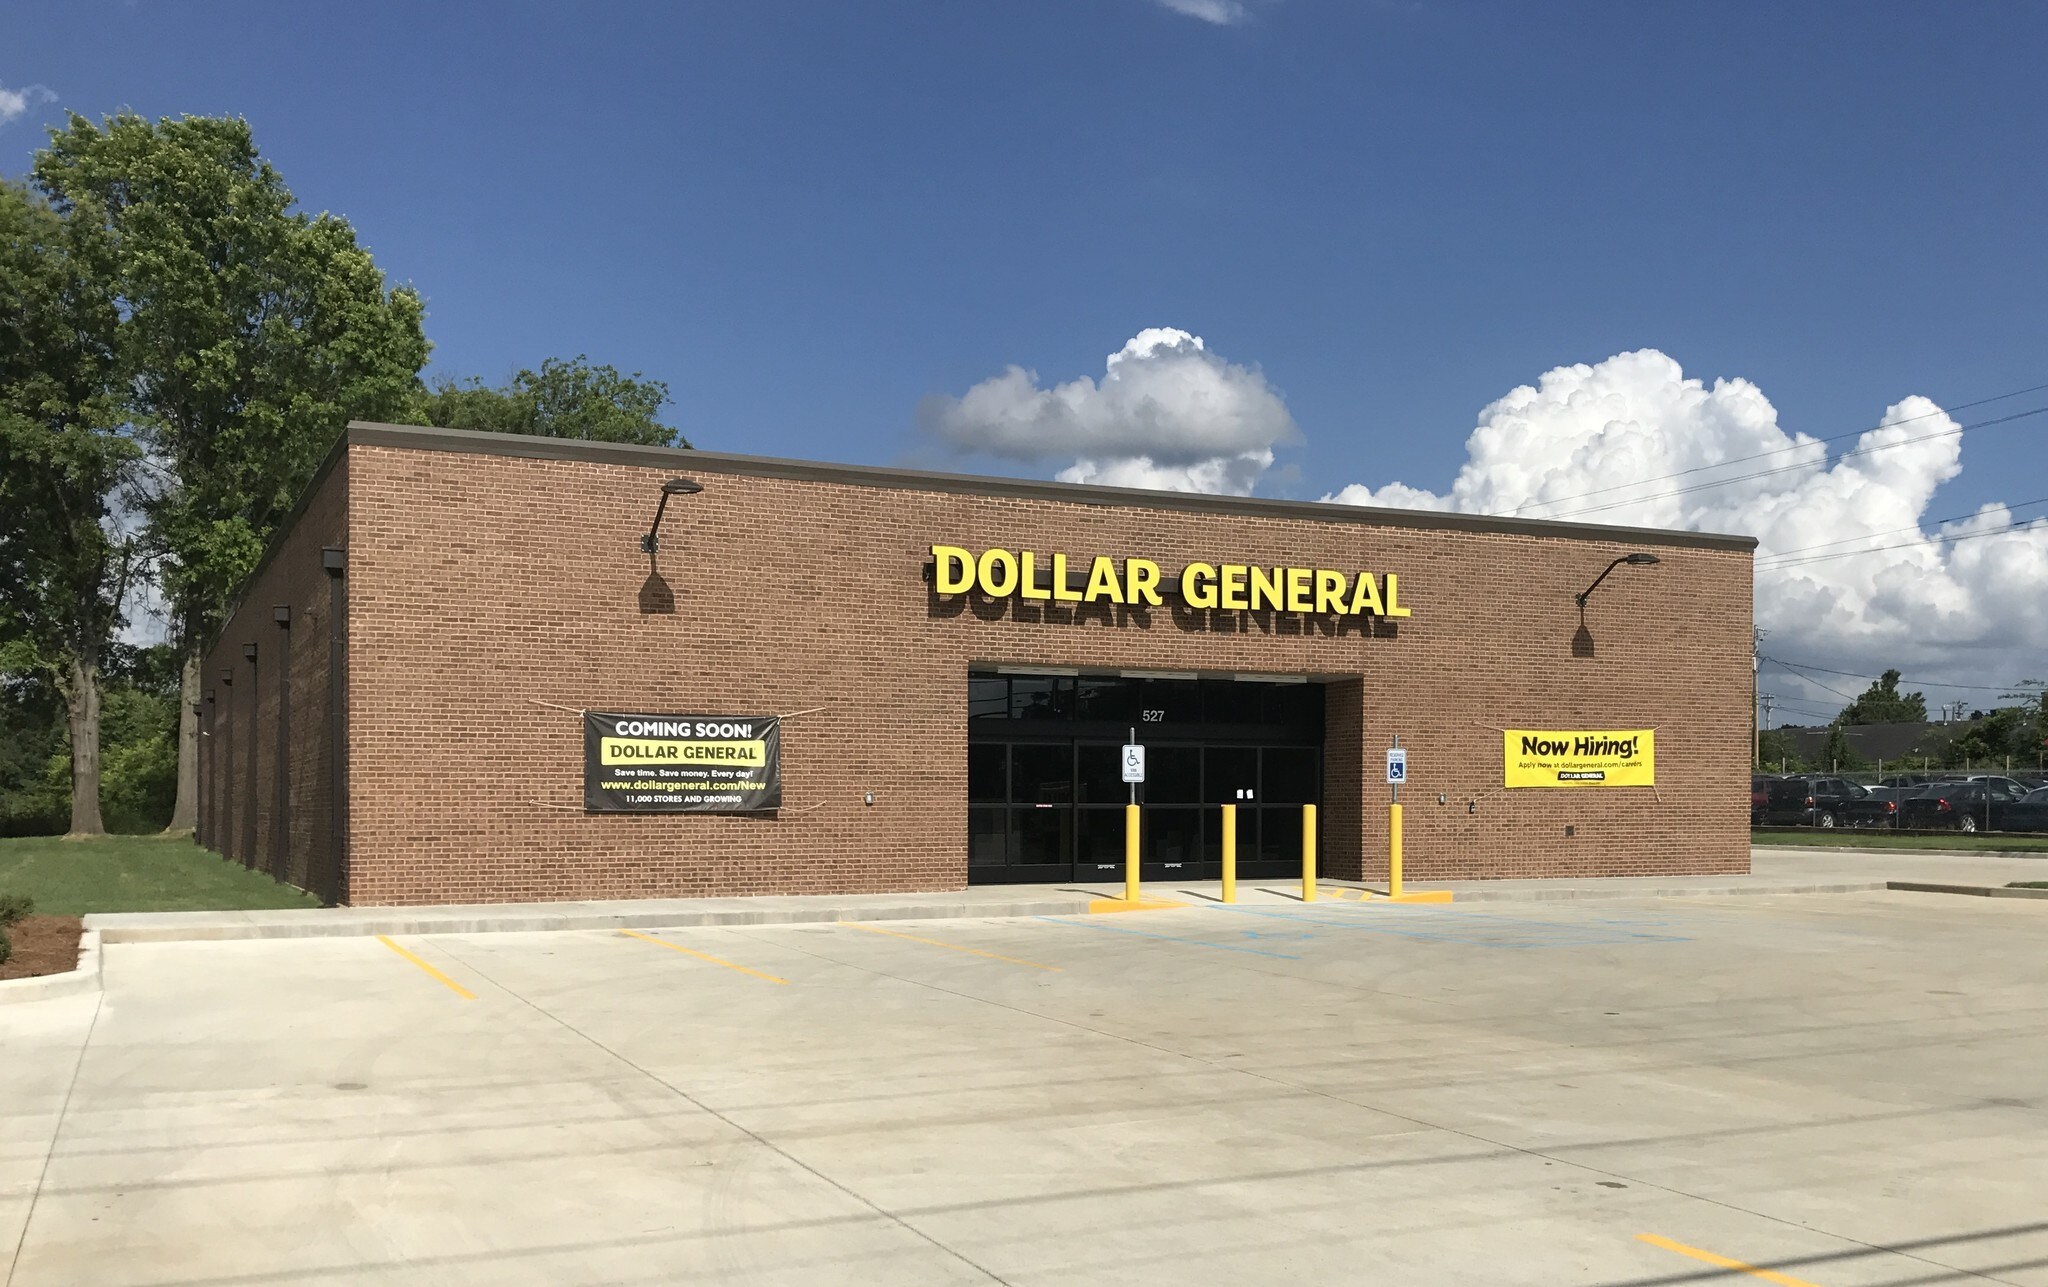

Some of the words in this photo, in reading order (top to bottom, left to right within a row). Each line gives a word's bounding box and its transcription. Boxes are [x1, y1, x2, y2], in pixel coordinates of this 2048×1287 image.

[931, 545, 1162, 606] DOLLAR
[1182, 562, 1411, 617] GENERAL
[1143, 710, 1165, 722] 527
[615, 721, 691, 737] COMING
[695, 724, 753, 738] SOON!
[610, 745, 678, 758] DOLLAR
[683, 746, 757, 760] GENERAL
[1521, 736, 1569, 755] Now
[1573, 736, 1639, 758] Hiring!
[614, 769, 635, 777] Save
[637, 769, 657, 777] time.
[681, 770, 710, 779] money.
[711, 770, 734, 779] Every
[601, 780, 766, 792] www.dollargeneral.com/New
[626, 795, 652, 803] 11,000
[654, 795, 682, 803] STORES
[684, 795, 702, 803] AND
[703, 795, 742, 803] GROWING
